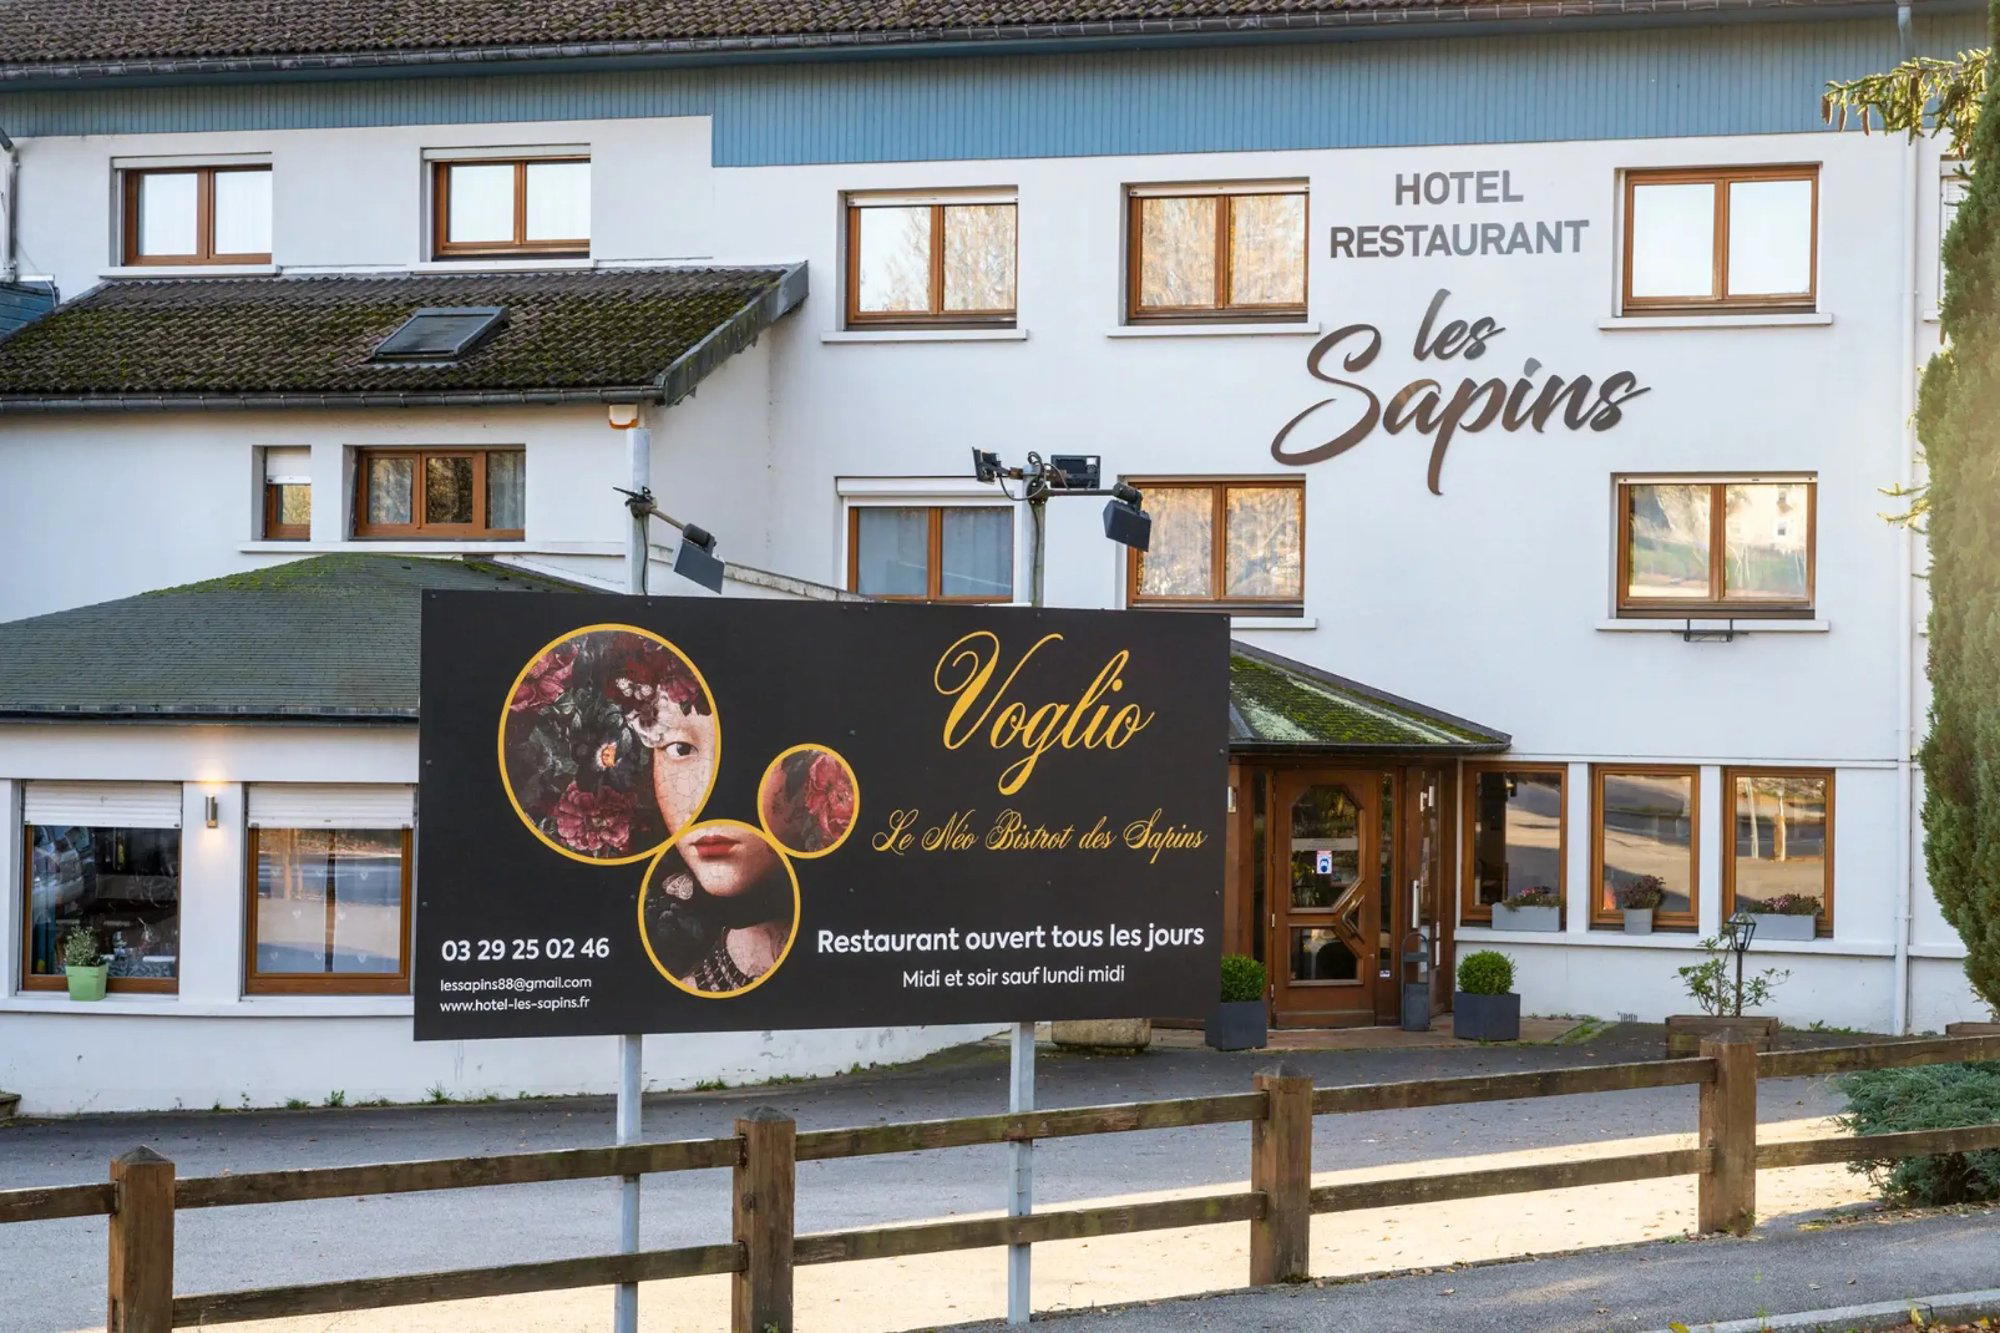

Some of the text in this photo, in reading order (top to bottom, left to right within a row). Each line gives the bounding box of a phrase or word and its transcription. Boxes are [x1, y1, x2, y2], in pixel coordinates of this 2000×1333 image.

[1395, 170, 1524, 206] HOTEL
[1330, 219, 1590, 259] RESTAURANT
[1412, 288, 1507, 362] les
[1270, 323, 1652, 497] Sapins
[933, 630, 1155, 796] Voglio
[872, 807, 1208, 865] Le Néo Bistrot des Sapins
[441, 937, 610, 962] 03 29 25 02 46
[817, 922, 1205, 954] Restaurant ouvert tous les jours
[440, 976, 592, 994] lessapins88@gmail.com
[902, 964, 1125, 988] Midi et soir sauf lundi midi
[439, 995, 591, 1013] www.hotel-les-sapins.fr
